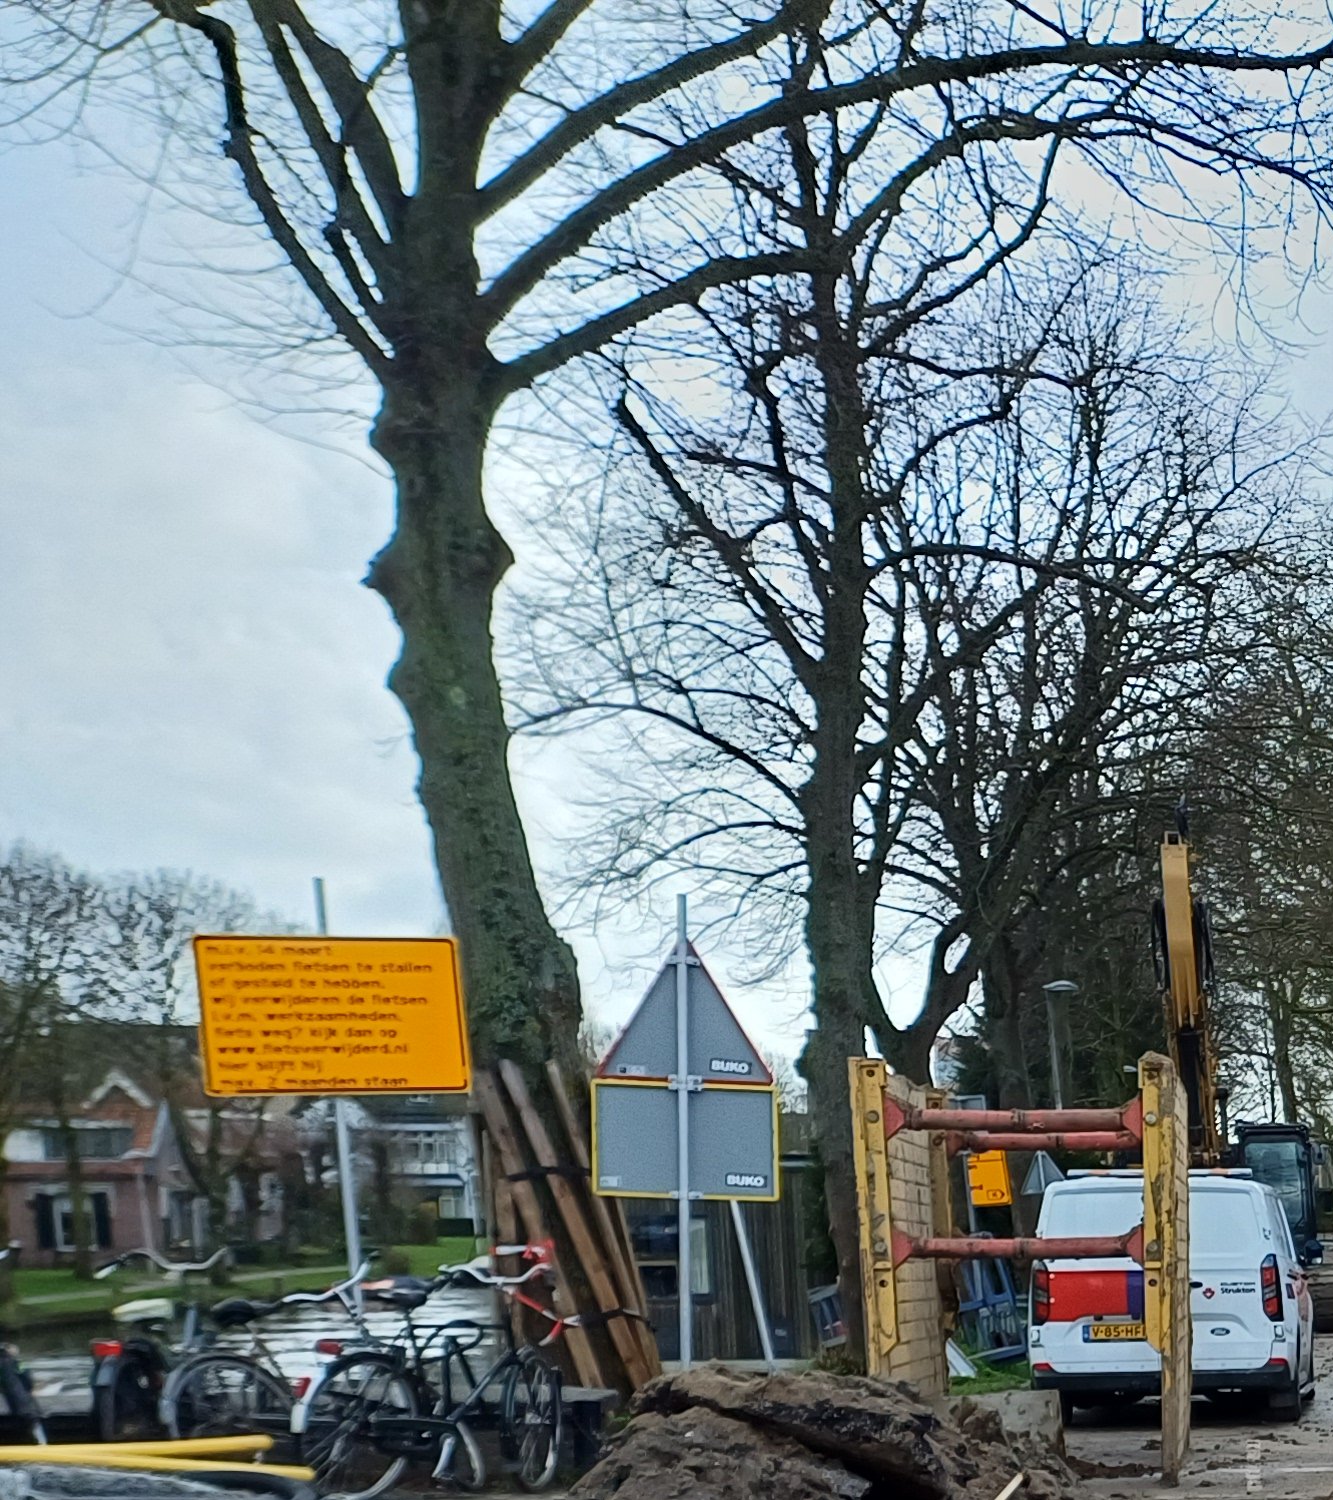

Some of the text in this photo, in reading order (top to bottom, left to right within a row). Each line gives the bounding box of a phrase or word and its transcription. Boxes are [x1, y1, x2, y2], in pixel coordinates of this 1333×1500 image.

[208, 961, 433, 973] verboden fietsen te stallen
[243, 994, 340, 1008] verwijderen
[349, 994, 366, 1005] de
[371, 994, 428, 1005] fietsen
[344, 1027, 373, 1038] dan
[711, 1060, 749, 1074] BUKO
[363, 1077, 409, 1088] staan
[727, 1174, 765, 1187] BUKO
